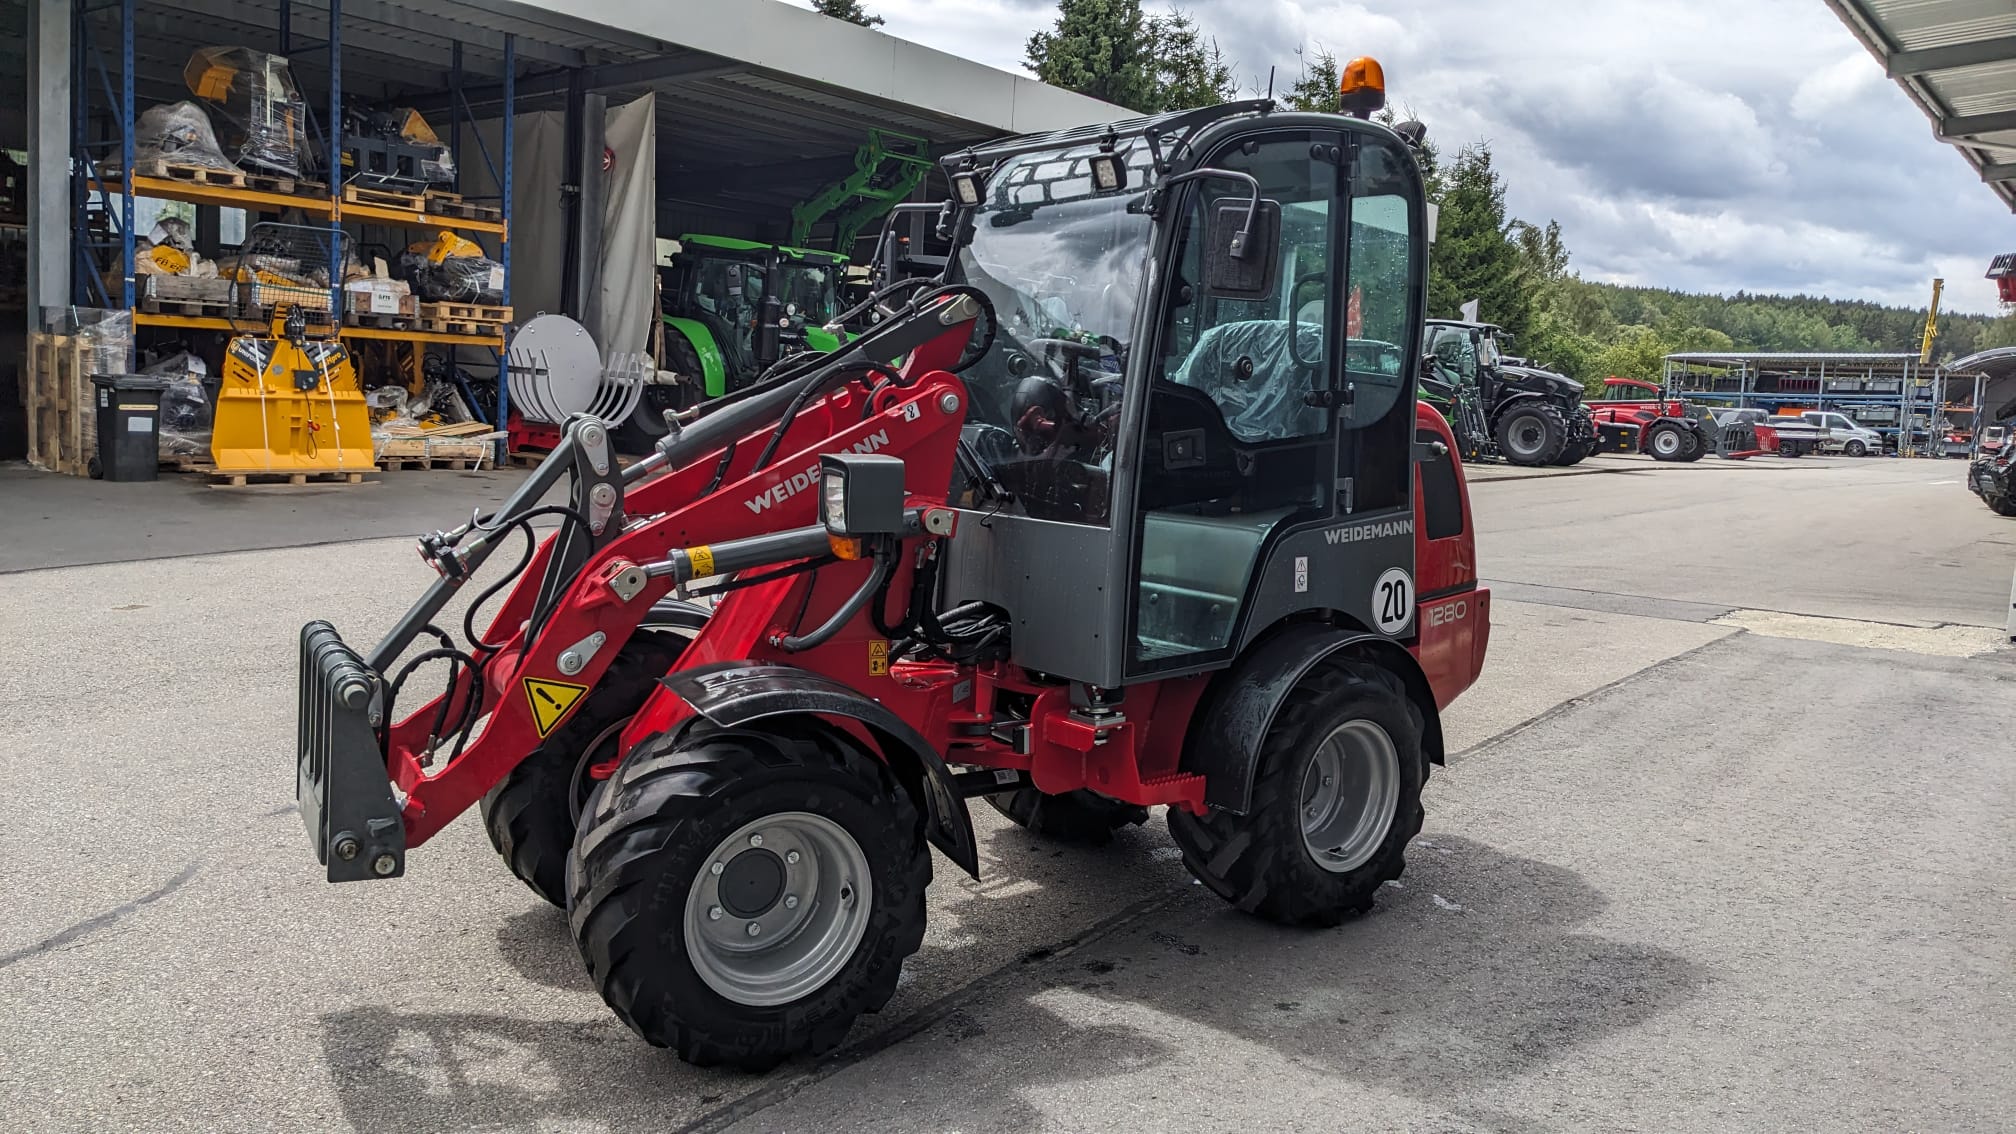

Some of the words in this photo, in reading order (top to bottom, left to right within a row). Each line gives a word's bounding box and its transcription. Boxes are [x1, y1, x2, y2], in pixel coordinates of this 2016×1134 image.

[744, 429, 890, 515] WEIDEANN
[1323, 519, 1414, 545] WEIDEMANN
[1381, 579, 1406, 624] 20
[1428, 601, 1467, 627] 1280
